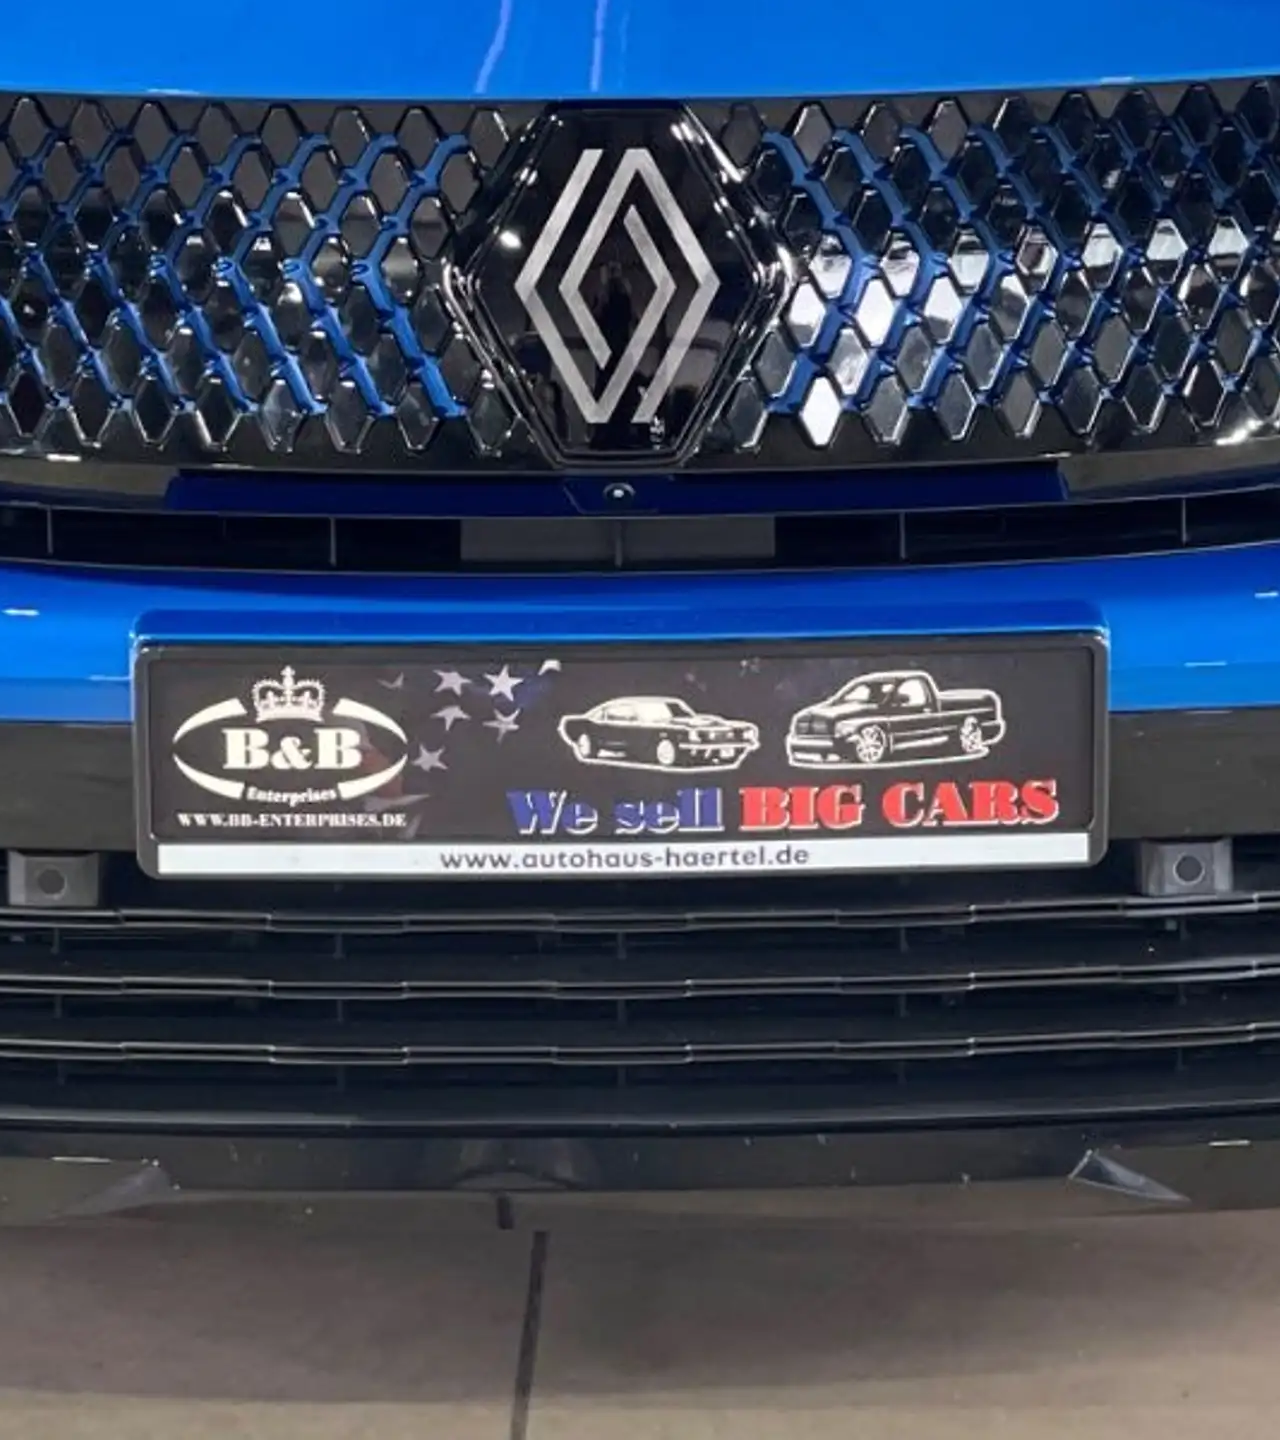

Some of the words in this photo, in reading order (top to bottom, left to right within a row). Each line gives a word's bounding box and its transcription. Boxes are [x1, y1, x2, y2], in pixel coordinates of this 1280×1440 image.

[222, 727, 362, 770] B&B
[246, 786, 337, 807] Enterprises
[506, 788, 598, 834] We
[614, 787, 725, 834] sell
[739, 782, 865, 831] BIG
[882, 778, 1059, 828] CARS
[177, 813, 407, 828] WWW.BB-ENTERPRISES.DE
[439, 844, 810, 870] www.autohaus-haertel.de
